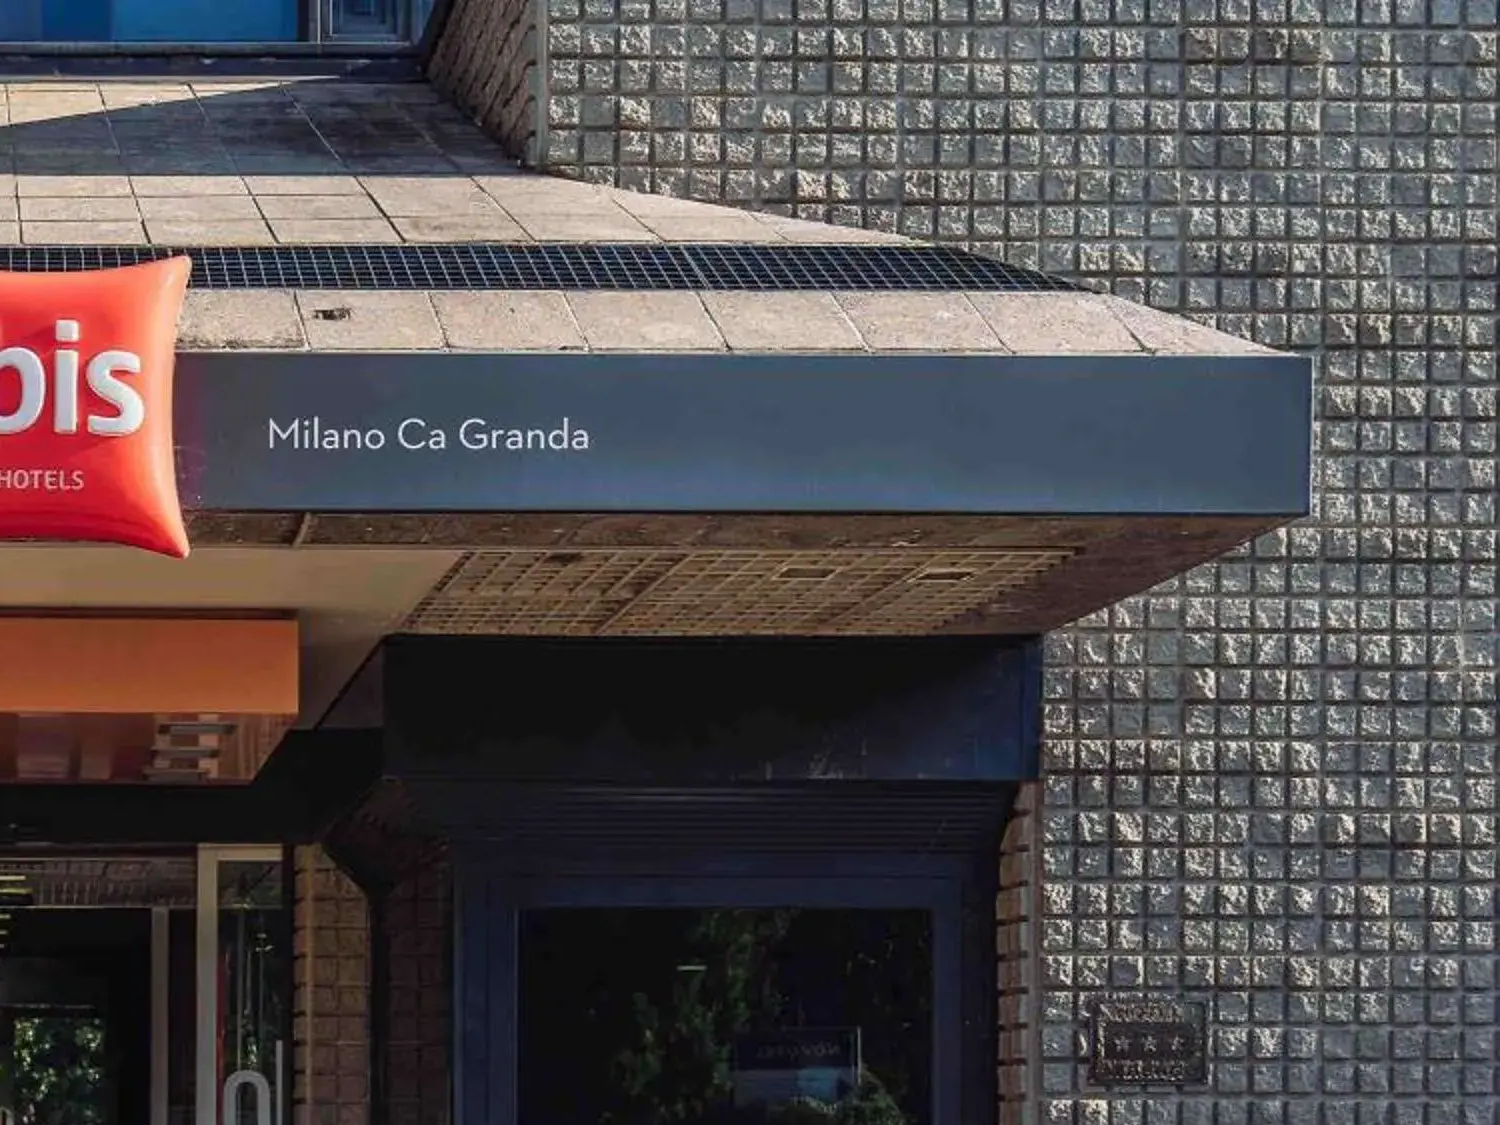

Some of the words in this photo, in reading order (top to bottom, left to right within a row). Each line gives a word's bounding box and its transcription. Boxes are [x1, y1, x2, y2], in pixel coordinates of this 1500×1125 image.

[267, 416, 386, 451] Milano
[397, 417, 447, 451] Ca
[458, 416, 591, 451] Granda
